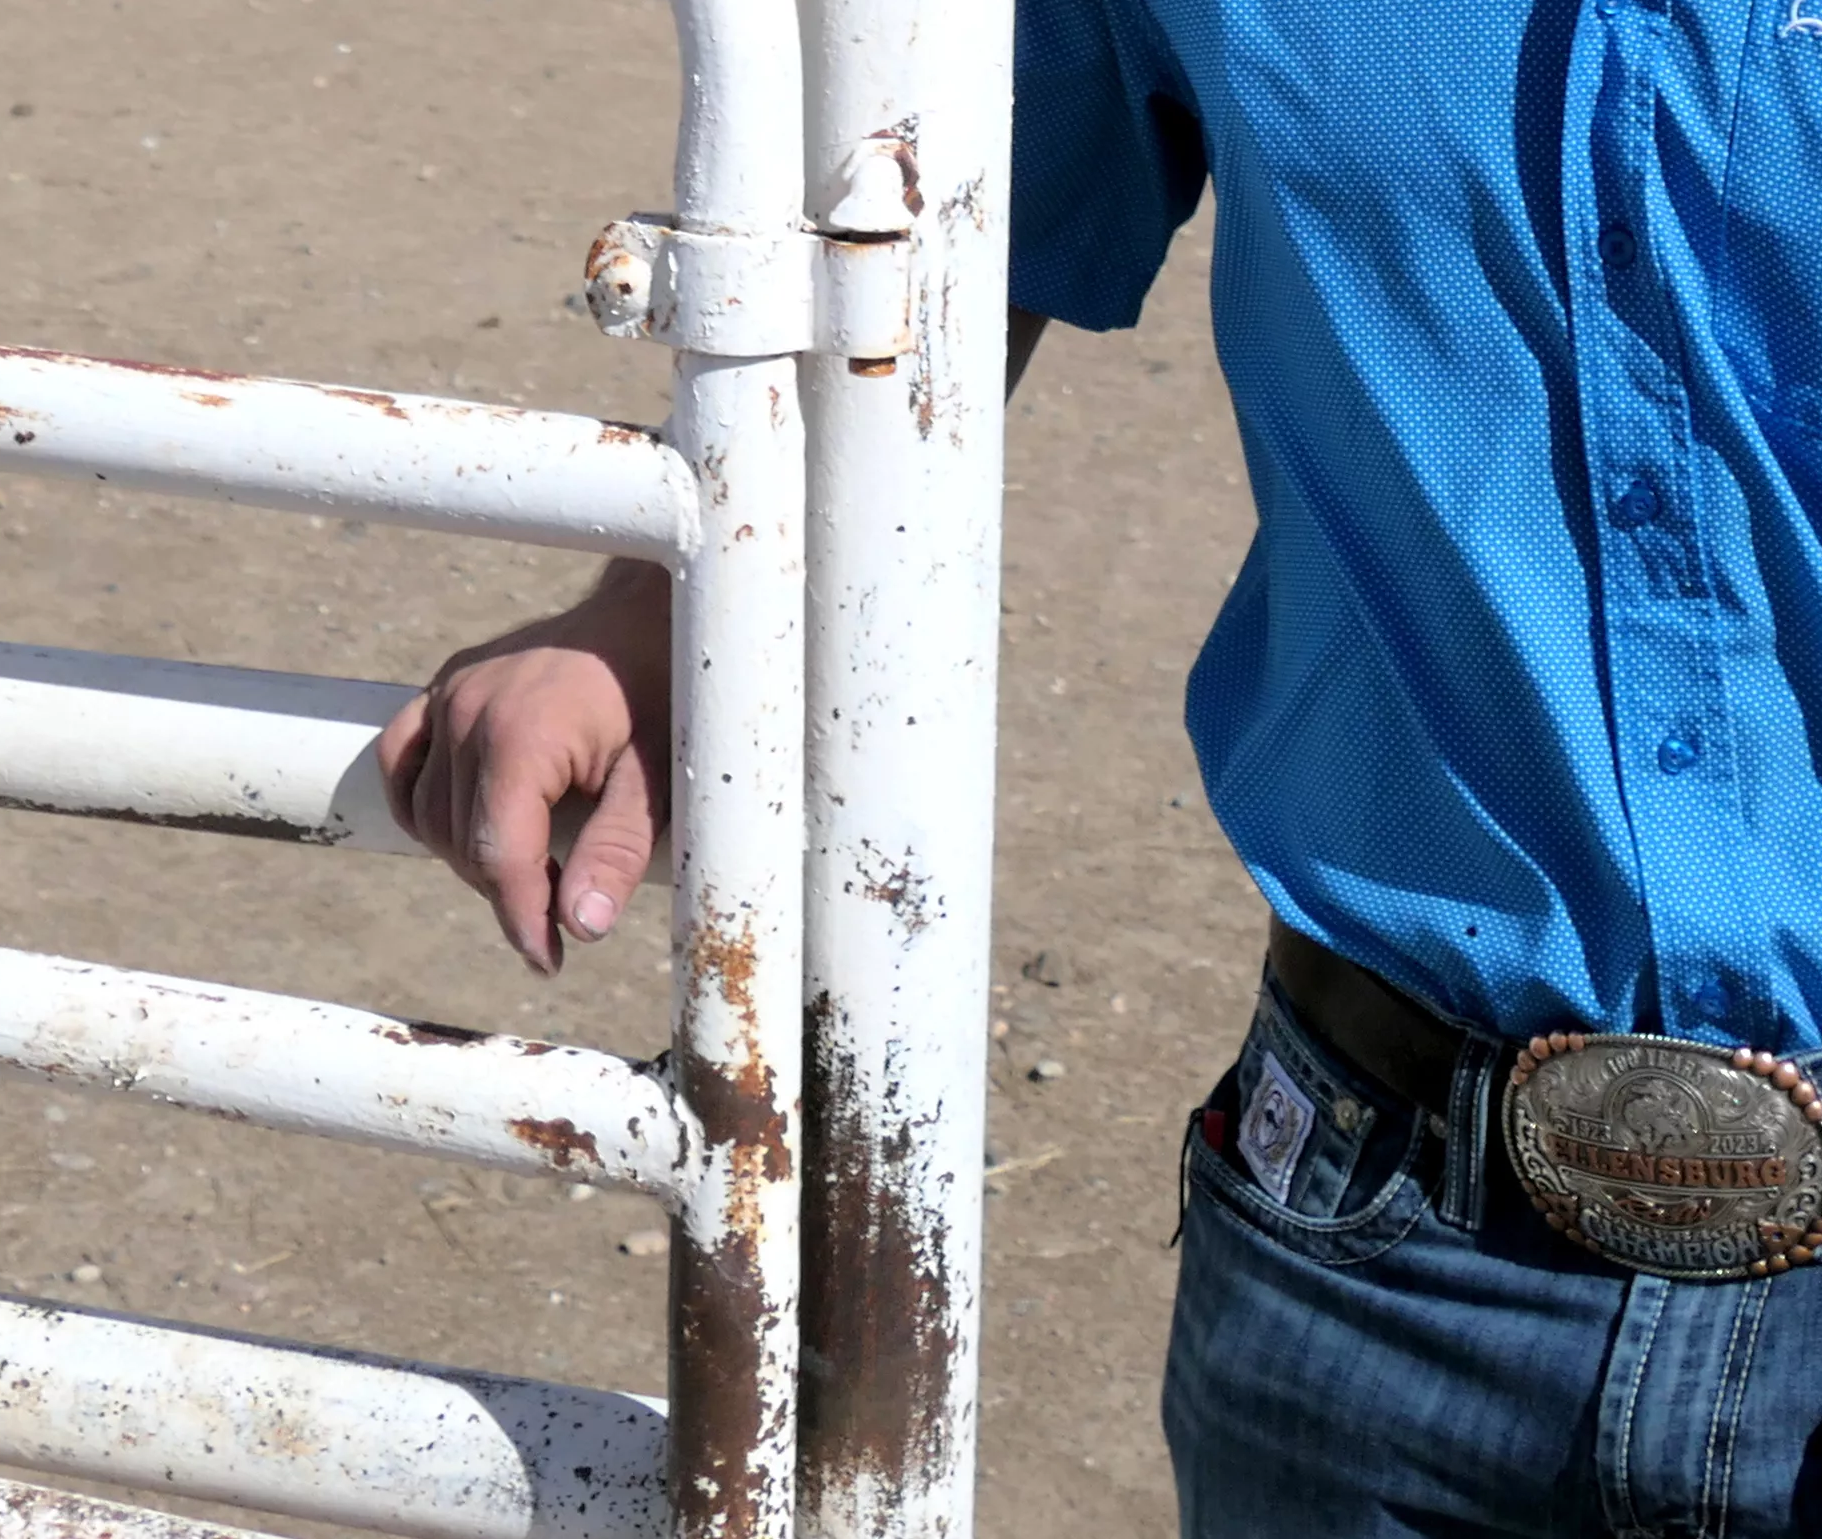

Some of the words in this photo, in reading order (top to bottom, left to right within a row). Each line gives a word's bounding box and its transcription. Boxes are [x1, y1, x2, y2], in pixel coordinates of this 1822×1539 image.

[1547, 1134, 1786, 1187] ELLENSBURG
[1710, 1133, 1758, 1155] 2023
[1579, 1207, 1760, 1266] CHAMPION
